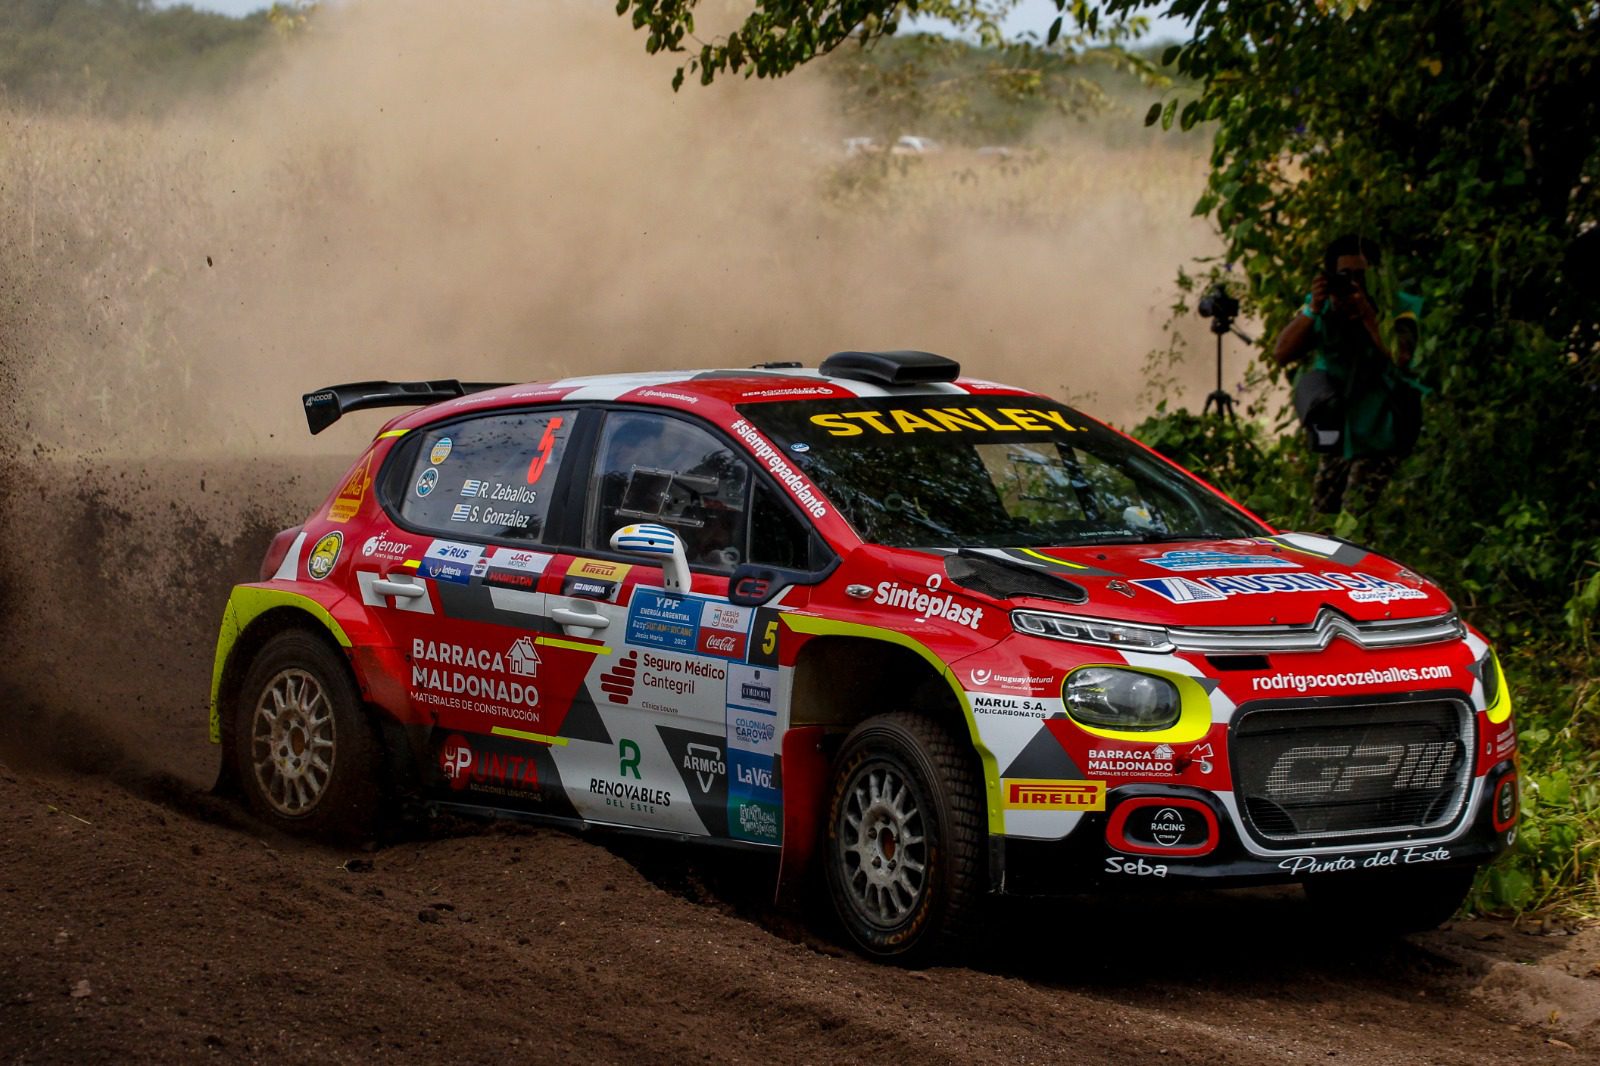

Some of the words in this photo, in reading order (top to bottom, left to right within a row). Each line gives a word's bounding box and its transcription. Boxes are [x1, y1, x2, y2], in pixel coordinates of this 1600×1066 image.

[809, 407, 1078, 437] STANLEY
[527, 417, 564, 485] 5
[731, 418, 827, 519] #siemprepadelante
[478, 480, 489, 498] R.
[491, 483, 537, 504] Zeballos
[469, 505, 480, 522] S.
[482, 506, 529, 529] González
[449, 547, 470, 559] RUS
[507, 559, 527, 568] MOTORS
[510, 552, 533, 562] JAC
[489, 571, 534, 587] HAMILTON
[581, 562, 617, 576] PIRELLI
[581, 583, 606, 594] INFINIA
[735, 577, 769, 598] C3
[1200, 573, 1341, 595] AUSIN
[655, 597, 681, 610] YPF
[722, 609, 740, 618] JESÚS
[873, 581, 984, 630] Sinteplast
[661, 610, 690, 622] ARGENTINA
[673, 638, 687, 646] 2025
[762, 620, 779, 656] 5
[412, 637, 505, 673] BARRACA
[643, 653, 682, 672] Seguro
[684, 656, 726, 681] Médico
[411, 665, 539, 708] MALDONADO
[642, 671, 695, 694] Cantegril
[410, 690, 461, 711] MATERIALES
[461, 698, 474, 712] DE
[473, 700, 540, 723] CONSTRUCCIÓN
[974, 707, 1046, 719] POLICARBONATOS
[975, 697, 1019, 709] NARUL
[1022, 701, 1047, 711] S.A.
[735, 718, 767, 730] COLONIA
[735, 726, 768, 742] CAROYA
[683, 754, 726, 776] ARMCO
[1088, 749, 1152, 760] BARRACA
[1088, 760, 1174, 772] MALDONADO
[589, 778, 671, 807] RENOVABLES
[1009, 783, 1098, 805] PIRELLI
[606, 798, 625, 808] DEL
[630, 801, 656, 814] ESTE
[1151, 822, 1186, 832] RACING
[1104, 856, 1169, 878] Seba
[1278, 855, 1356, 876] Punta
[1363, 850, 1398, 867] del
[1402, 845, 1451, 864] Este
